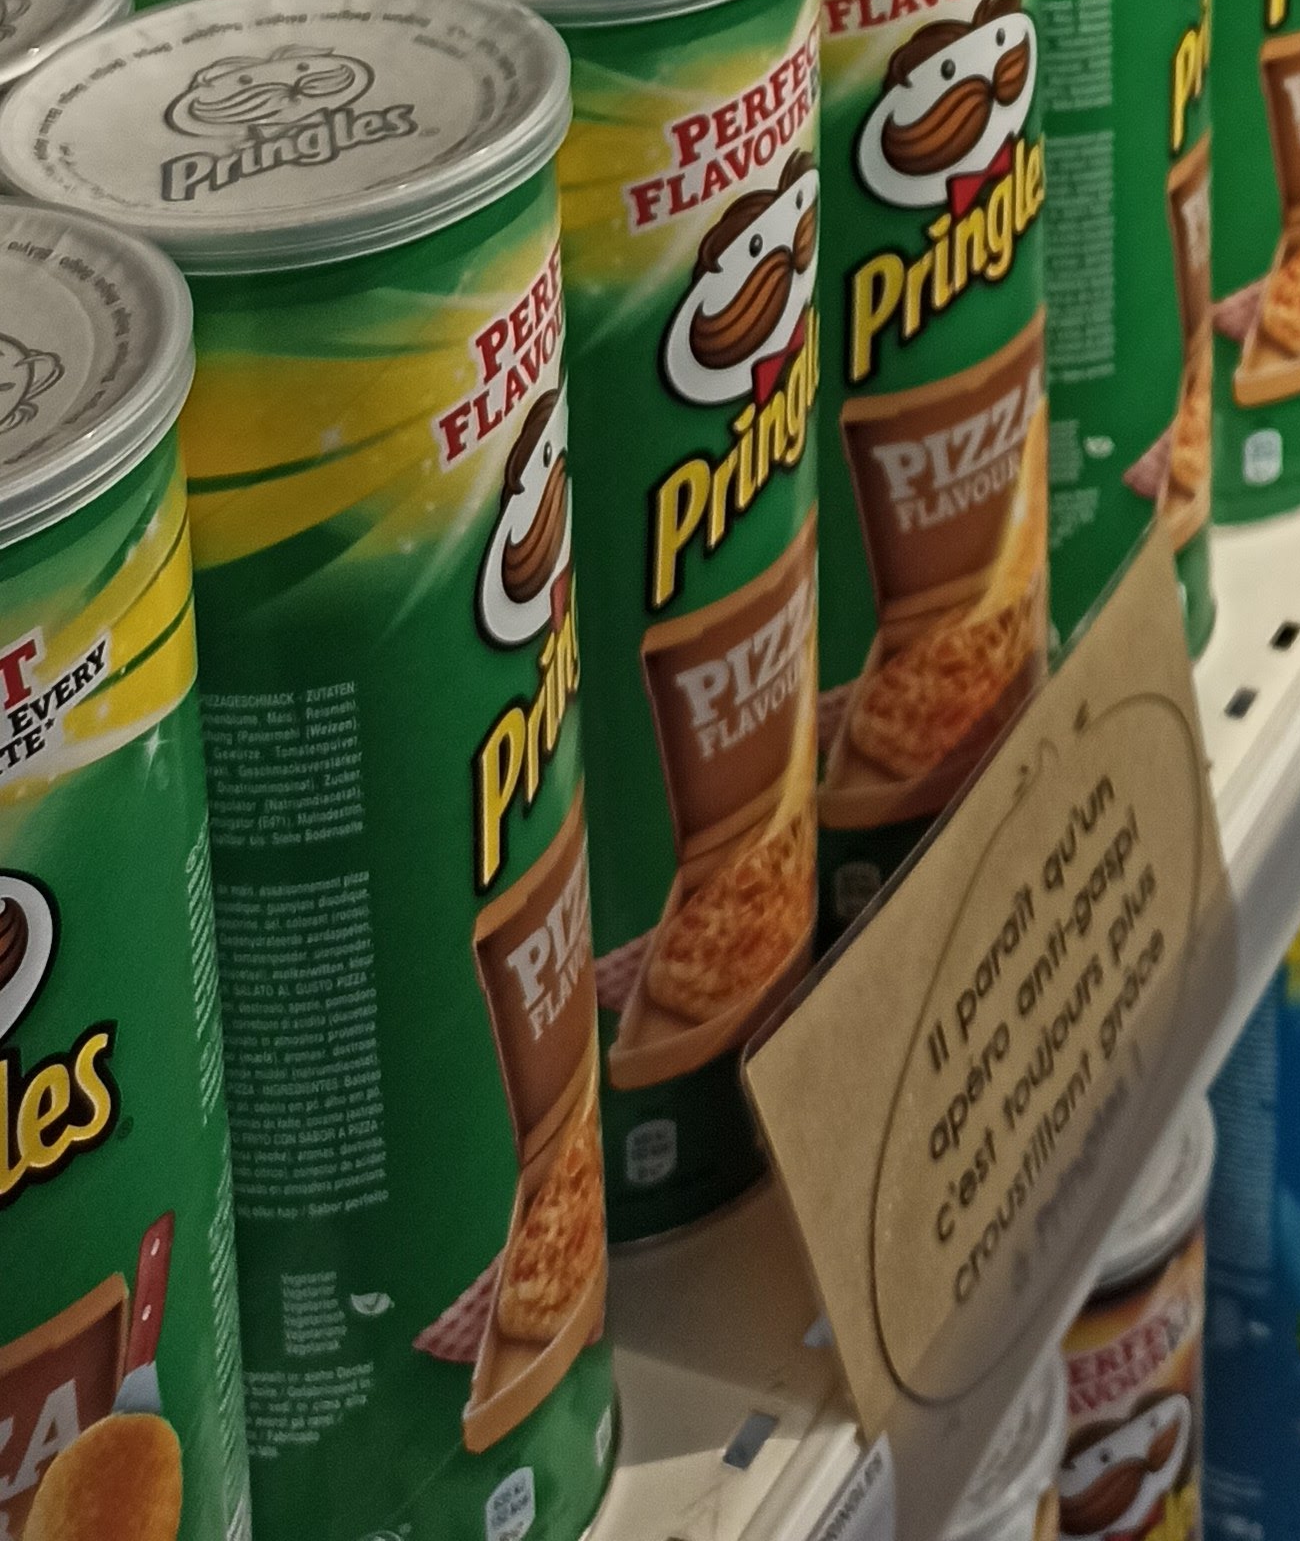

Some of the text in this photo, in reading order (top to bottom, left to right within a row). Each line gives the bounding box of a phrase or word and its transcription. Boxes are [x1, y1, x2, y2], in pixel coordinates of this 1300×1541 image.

[160, 101, 419, 203] Pringles
[11, 638, 108, 739] EVERY
[1042, 773, 1115, 894] qu'un
[928, 806, 1141, 1163] apéro anti-gaspi
[935, 861, 1158, 1245] c'est toujours plus
[954, 1047, 1093, 1305] croustillant
